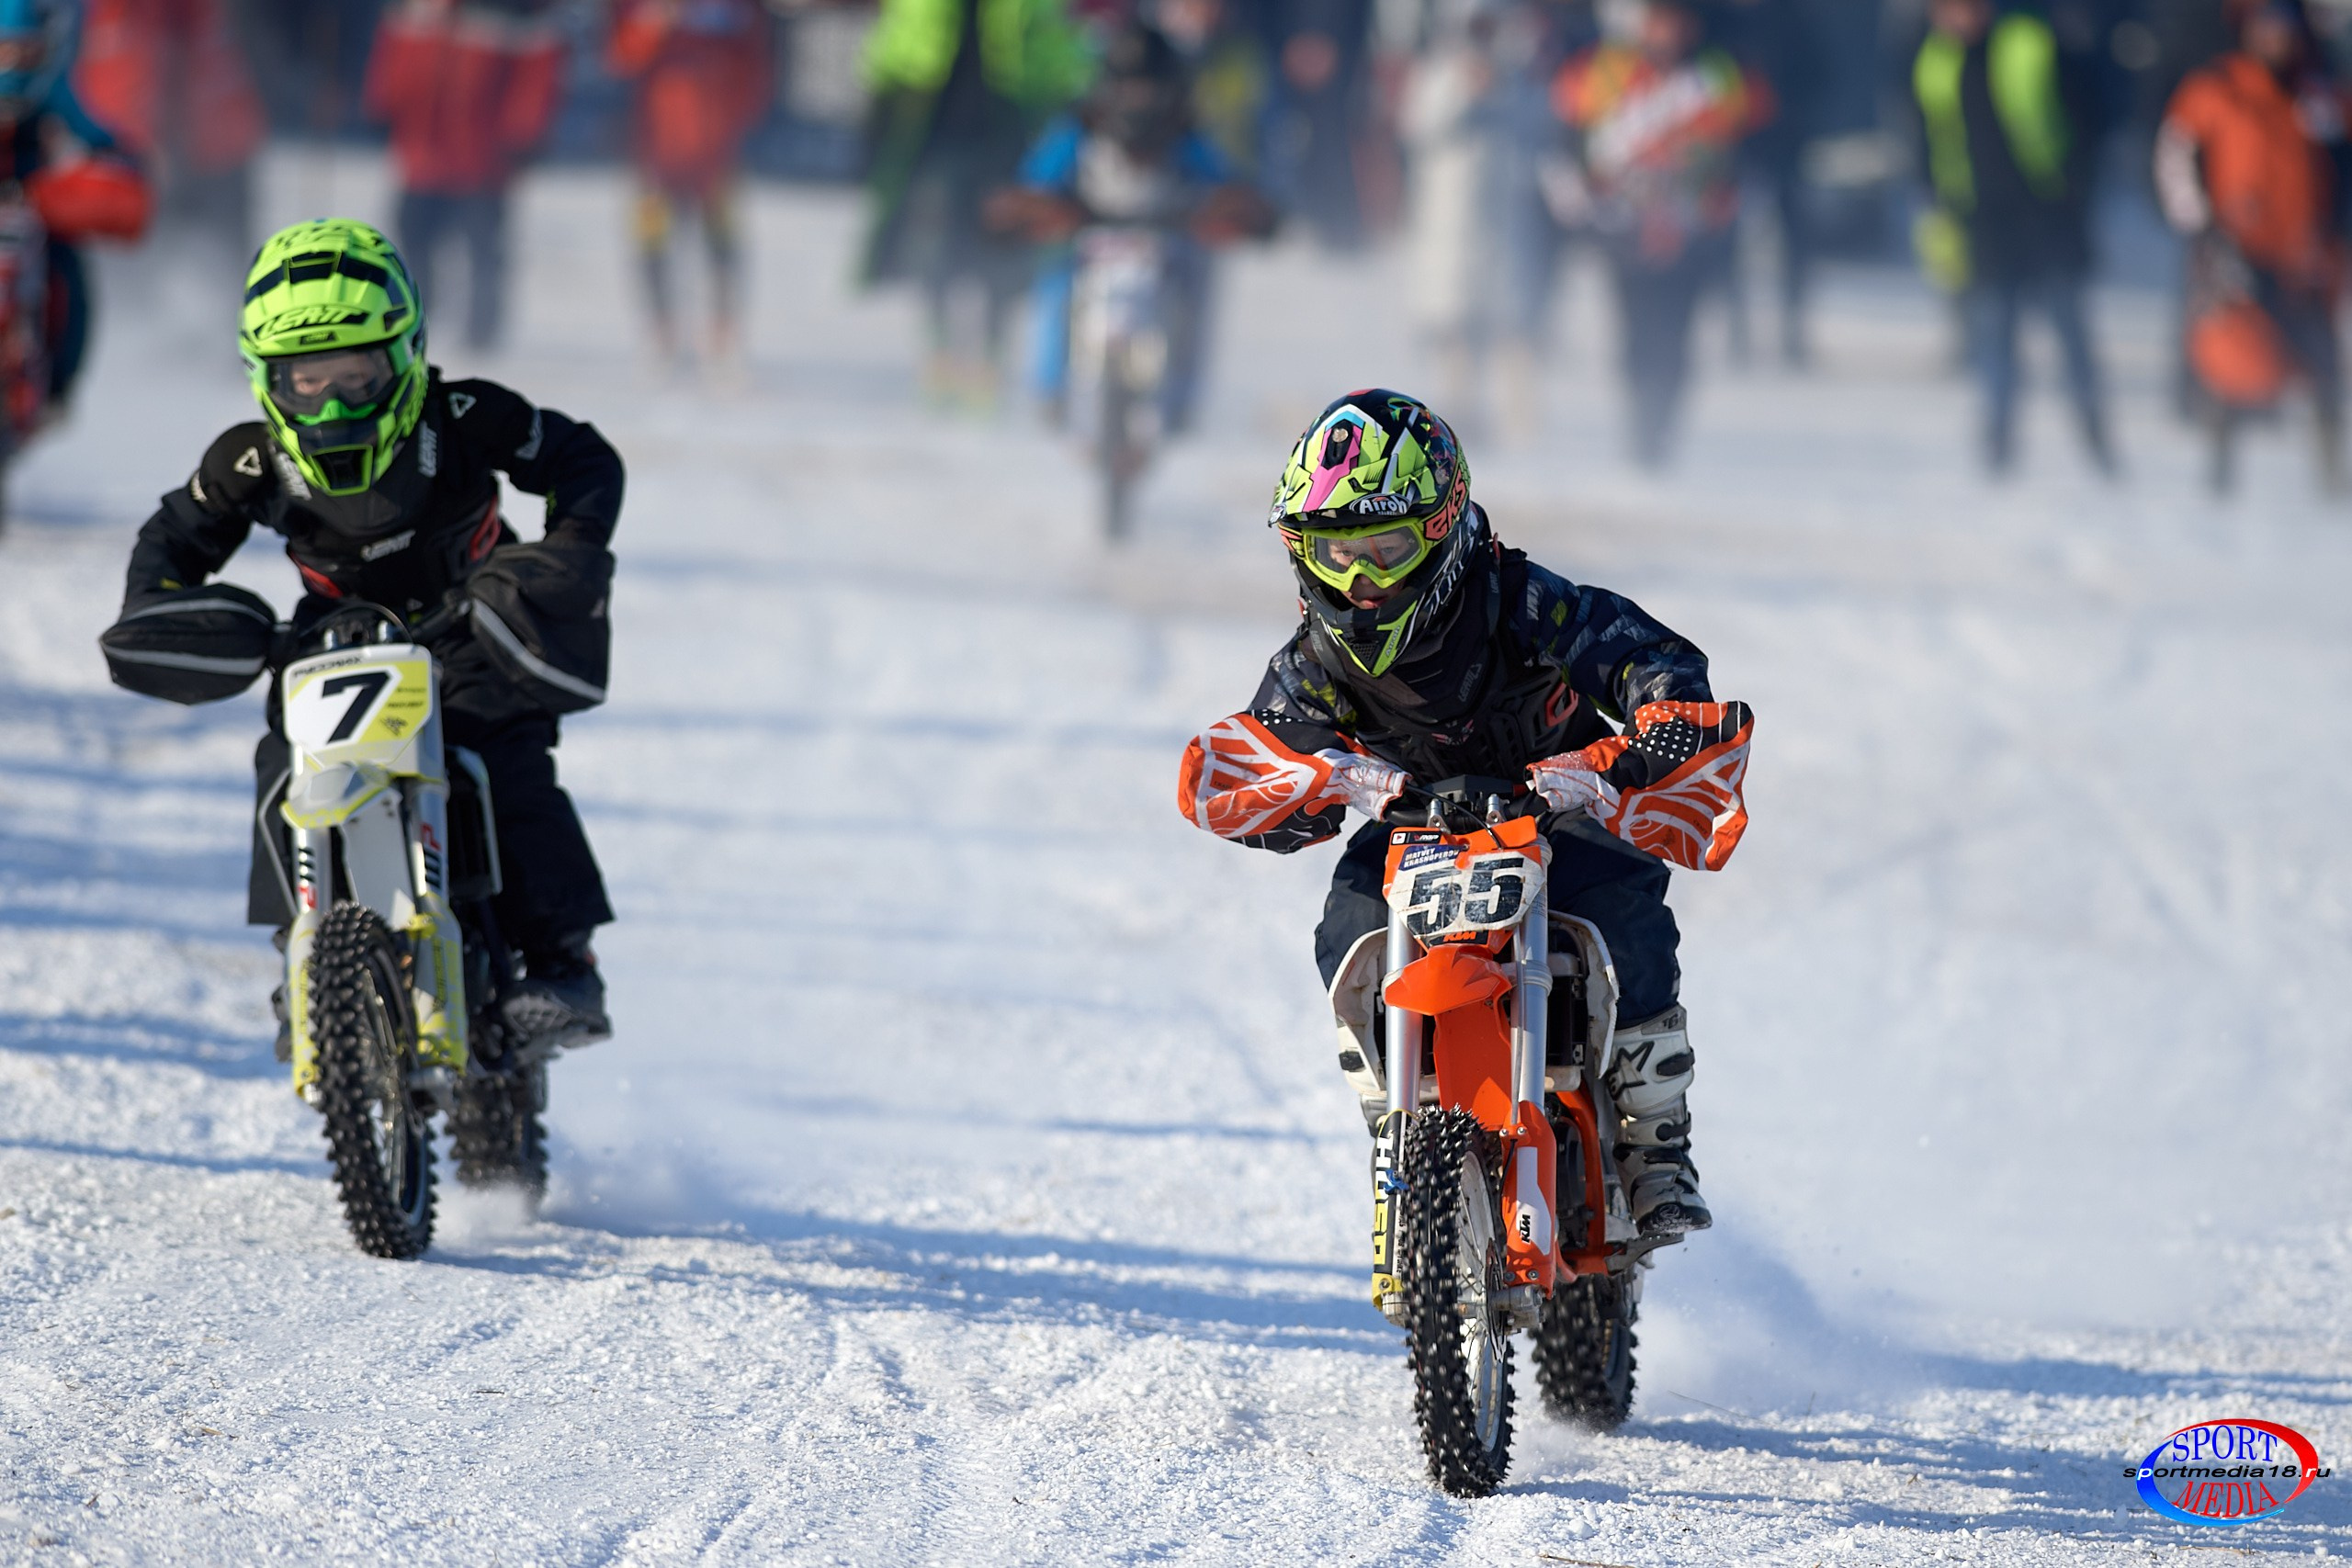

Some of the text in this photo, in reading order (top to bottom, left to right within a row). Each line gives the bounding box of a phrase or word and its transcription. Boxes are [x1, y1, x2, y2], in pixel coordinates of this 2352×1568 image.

[1360, 496, 1407, 514] Airoh
[322, 670, 390, 745] 7
[1406, 848, 1435, 861] MATVEY
[1407, 858, 1524, 936] 55
[1519, 1214, 1532, 1244] KTM
